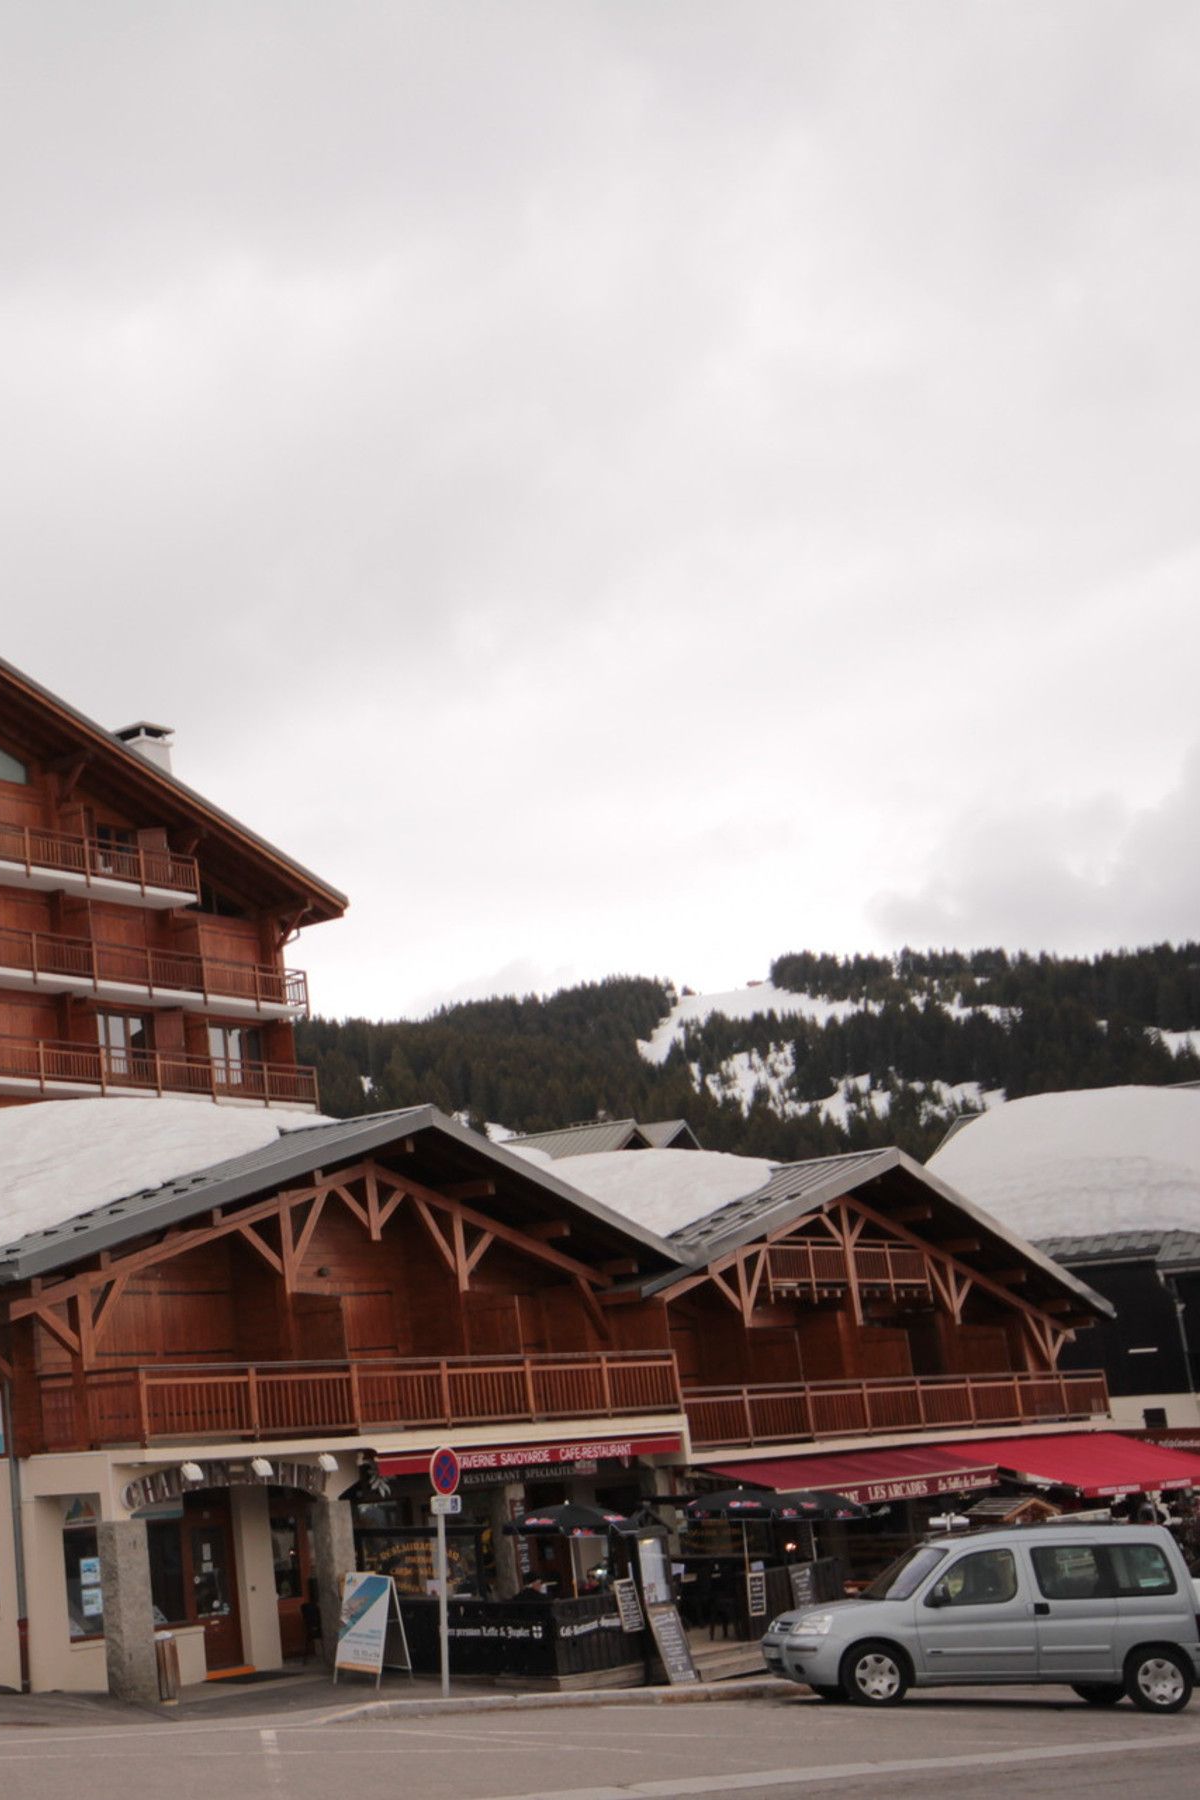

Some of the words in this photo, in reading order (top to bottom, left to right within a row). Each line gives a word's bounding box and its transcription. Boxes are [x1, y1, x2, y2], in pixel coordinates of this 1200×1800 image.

[458, 1454, 497, 1468] TAVERNE
[500, 1451, 550, 1465] SAVOYARDE
[868, 1485, 886, 1501] LES
[888, 1480, 928, 1498] ARCADES
